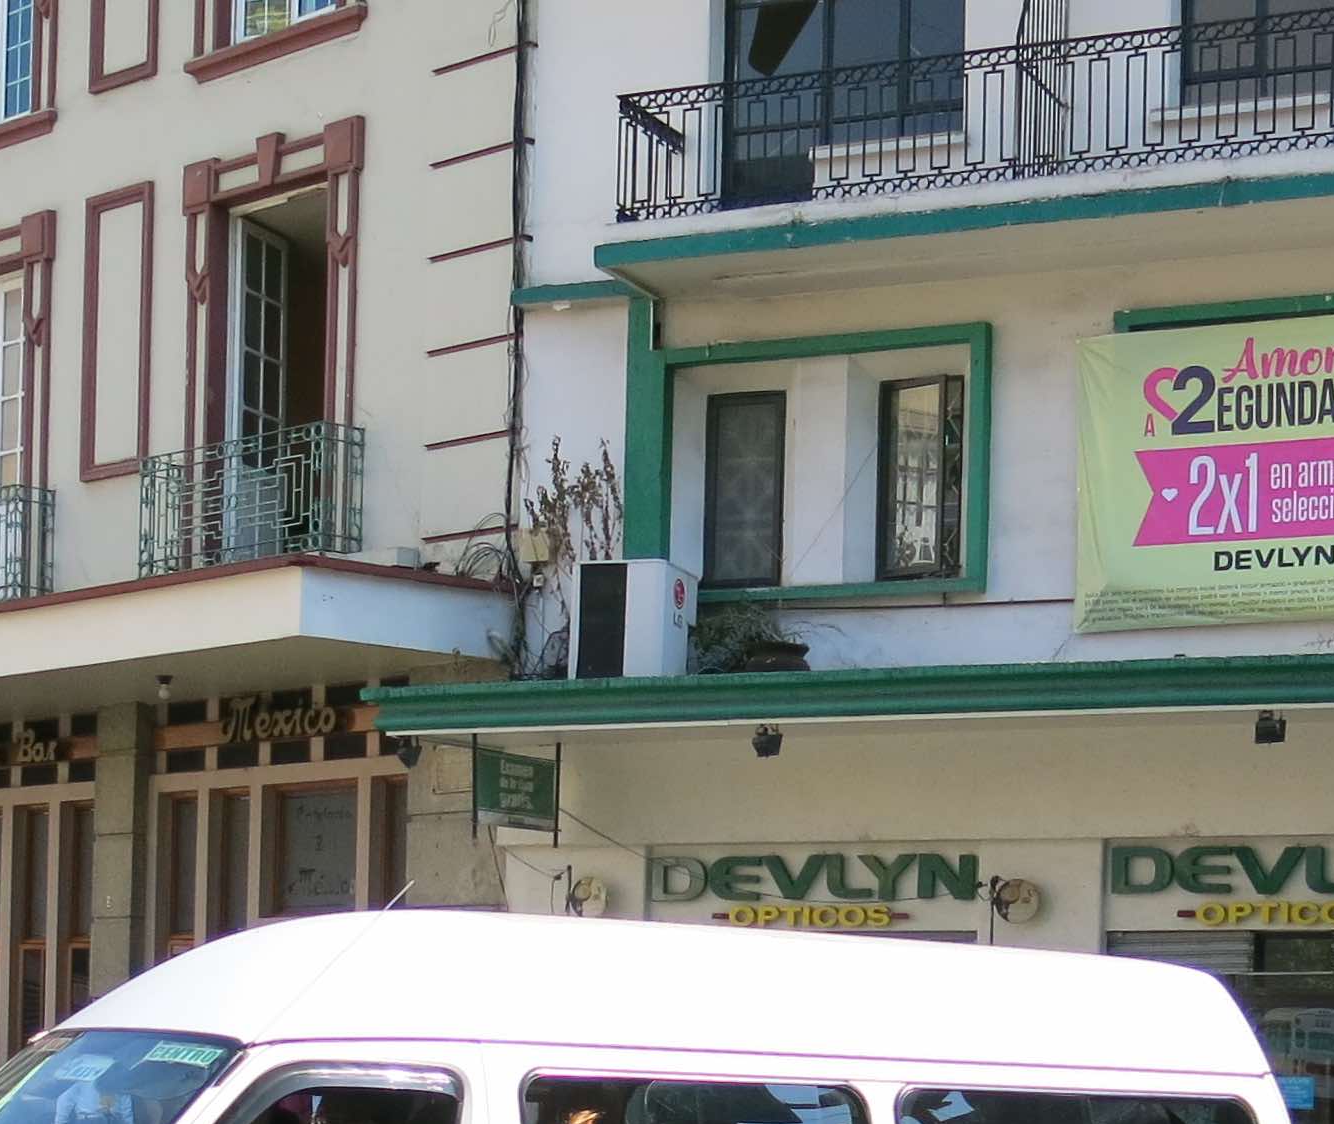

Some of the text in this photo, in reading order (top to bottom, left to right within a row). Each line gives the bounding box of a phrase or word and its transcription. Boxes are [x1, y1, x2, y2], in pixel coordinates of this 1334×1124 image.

[1144, 414, 1155, 437] A
[1270, 460, 1292, 489] en
[1188, 452, 1259, 536] 2x1
[13, 728, 58, 765] Bar
[651, 853, 978, 901] DEVLYN
[728, 904, 892, 928] OPTICOS
